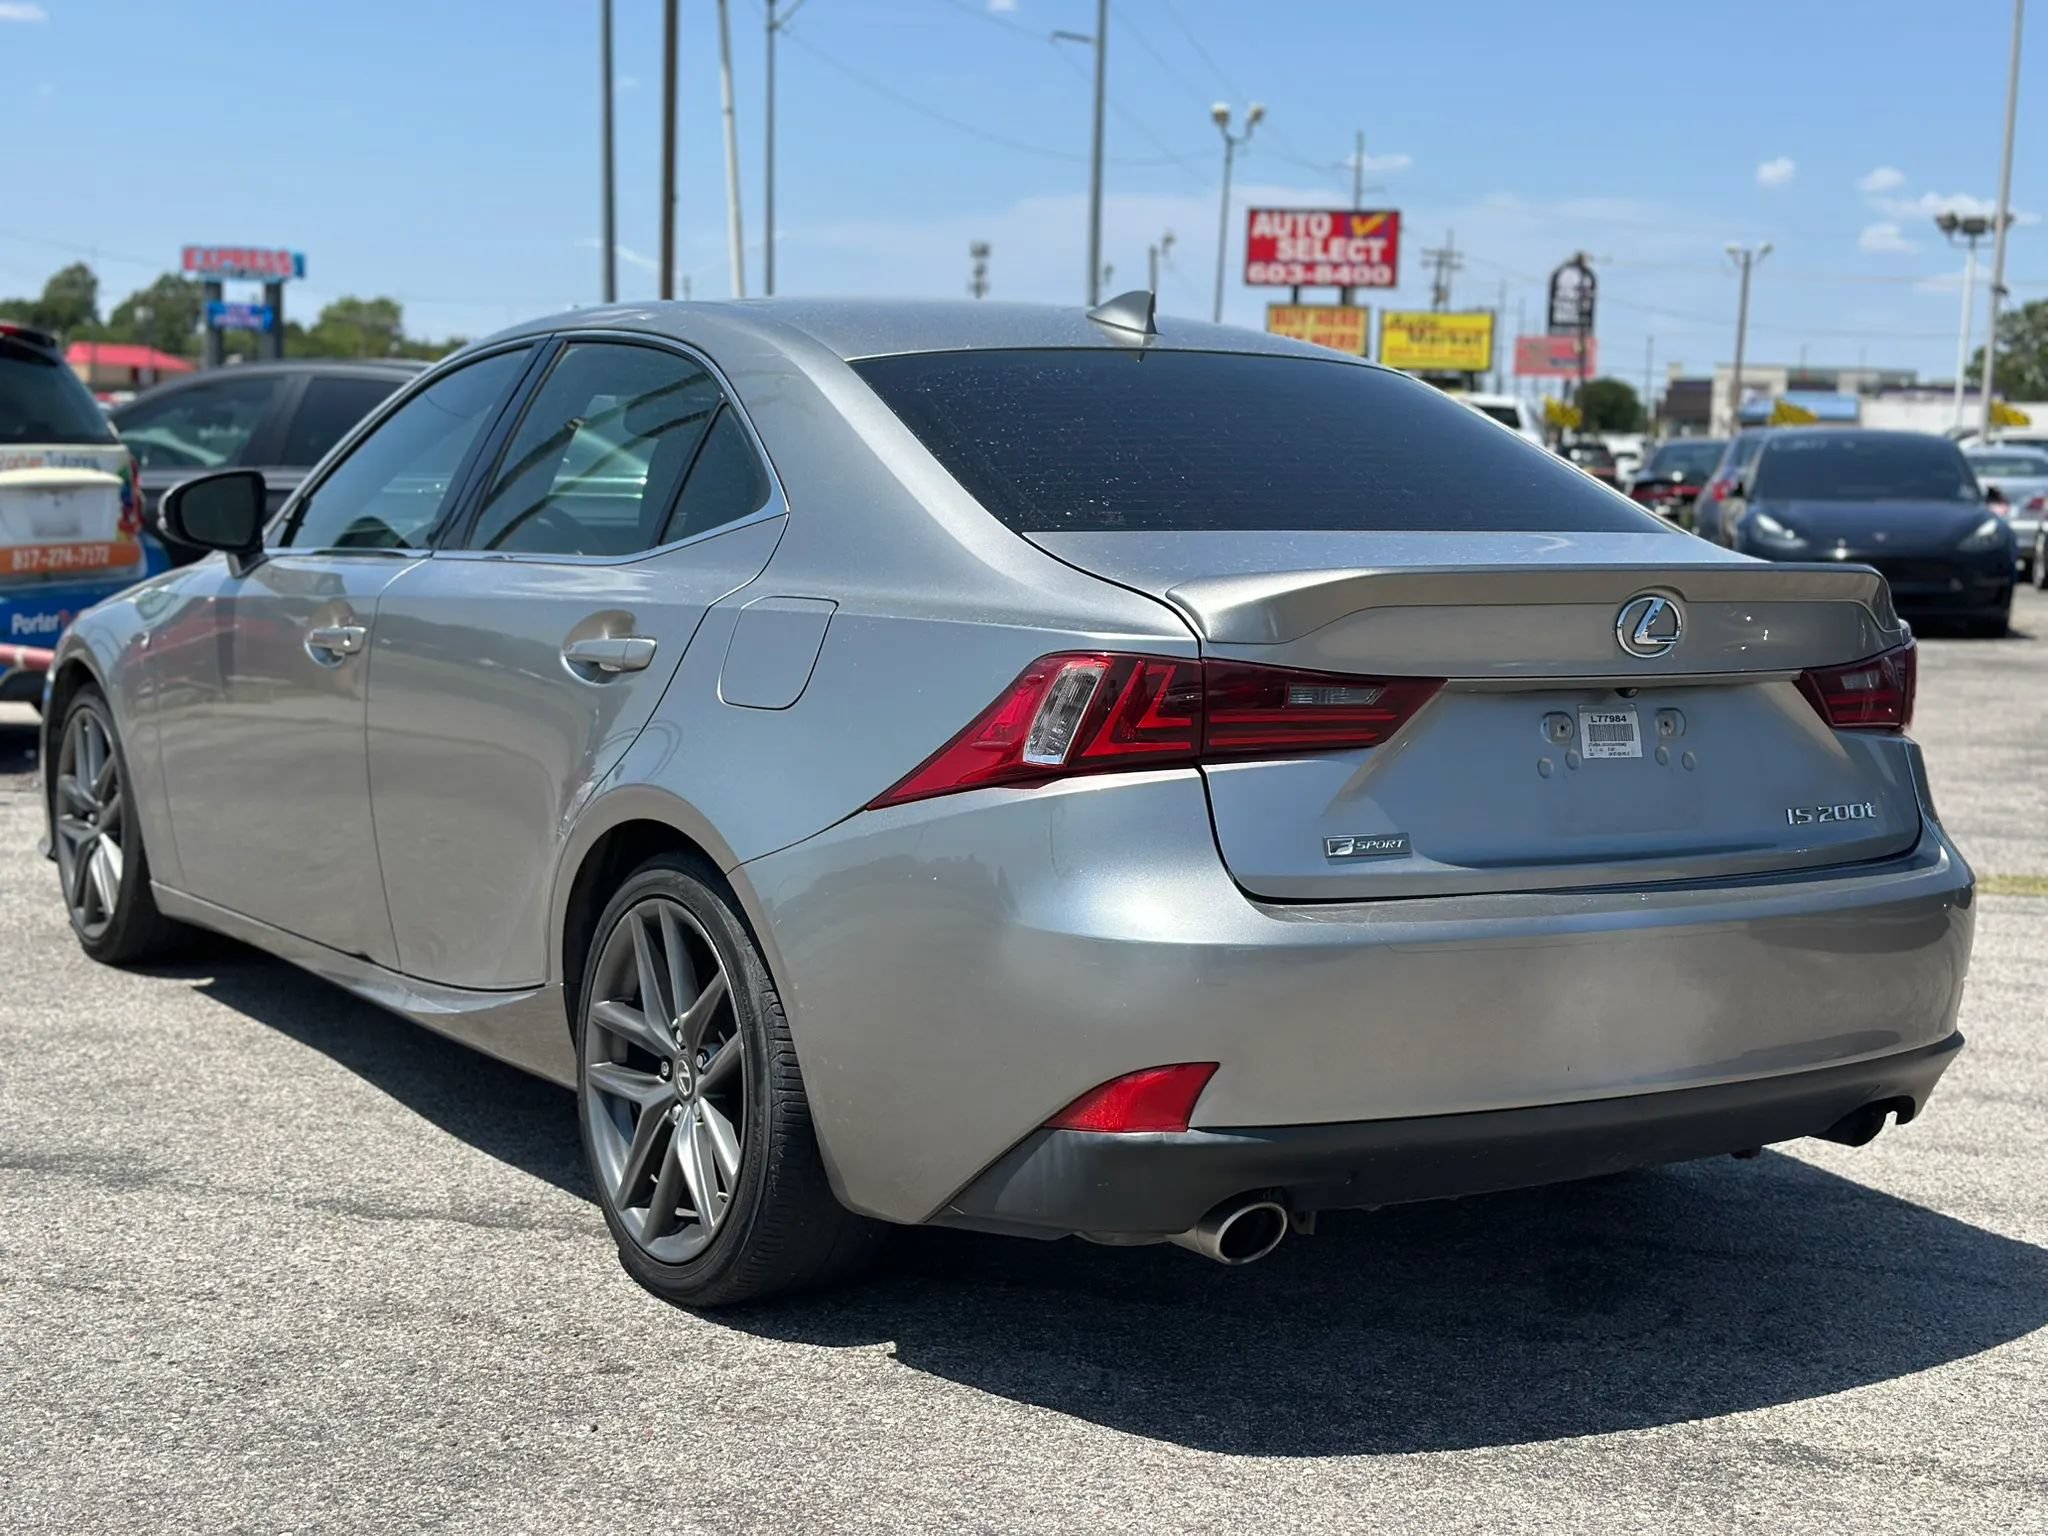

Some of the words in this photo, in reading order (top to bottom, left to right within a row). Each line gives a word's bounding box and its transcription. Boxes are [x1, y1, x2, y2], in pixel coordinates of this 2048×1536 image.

[1251, 211, 1332, 239] AUTO
[1276, 237, 1387, 263] SELECT
[1590, 714, 1628, 723] L77984
[1786, 807, 1813, 825] IS
[1816, 802, 1877, 823] 200t
[1355, 839, 1406, 850] SPORT
